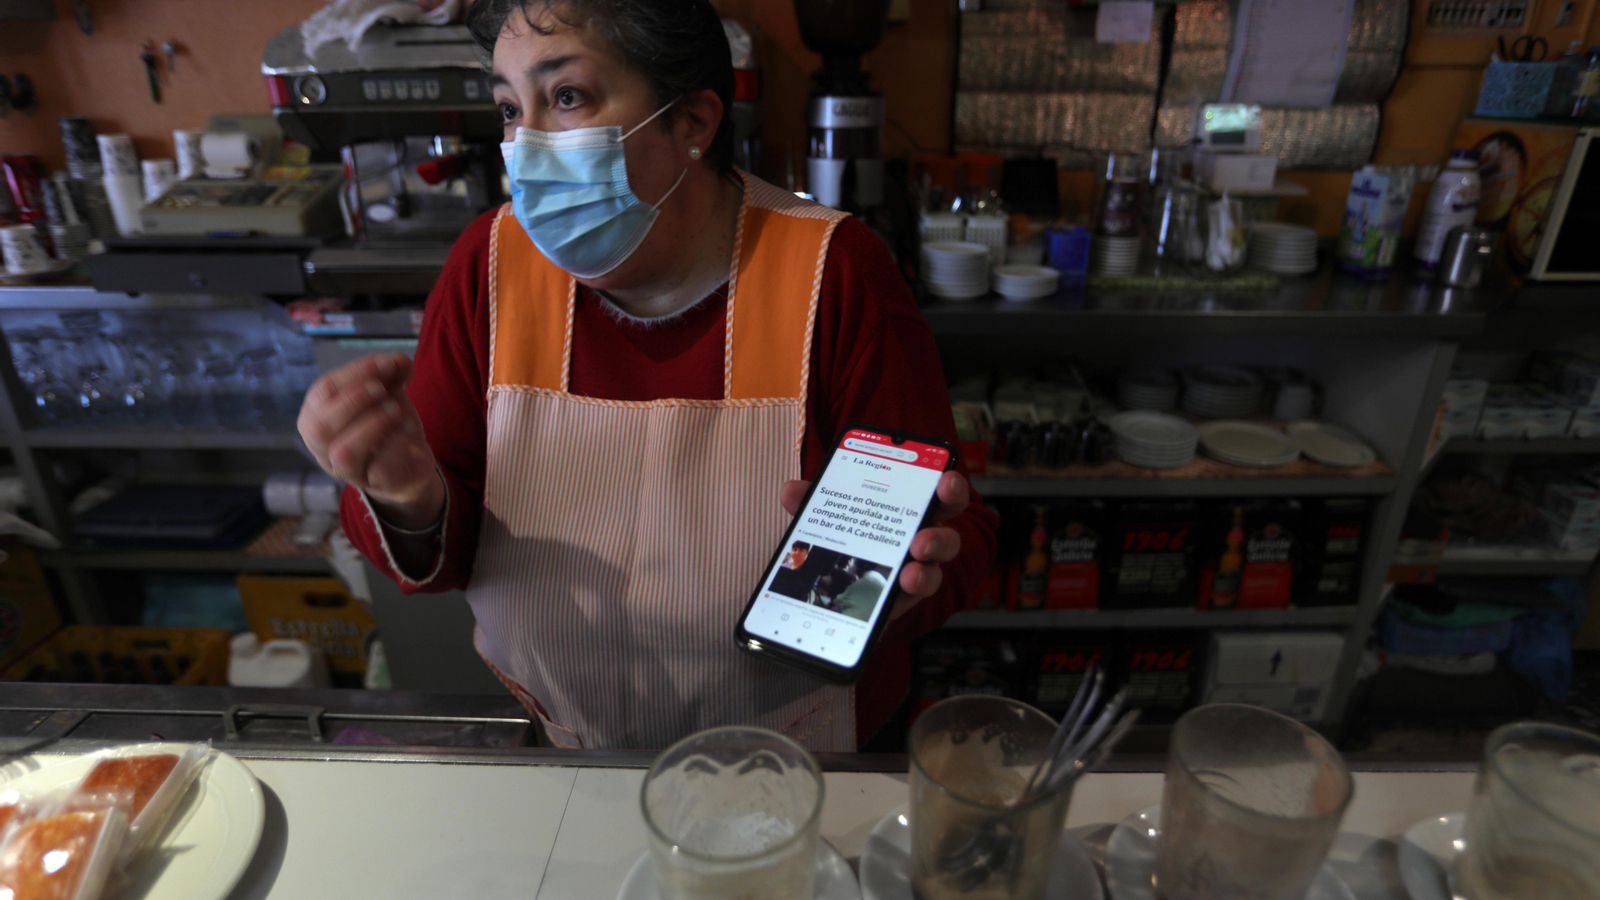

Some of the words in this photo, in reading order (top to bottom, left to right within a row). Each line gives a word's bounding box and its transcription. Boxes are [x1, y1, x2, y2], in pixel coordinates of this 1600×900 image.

[853, 457, 864, 465] La
[820, 487, 852, 502] Sucesos
[853, 495, 864, 504] en
[865, 497, 901, 513] Ourense
[906, 507, 918, 517] Un
[823, 498, 848, 512] joven
[849, 503, 883, 520] apuñala
[891, 515, 903, 524] un
[808, 516, 819, 525] un
[820, 518, 834, 531] bar
[835, 522, 847, 533] de
[847, 525, 853, 534] A
[854, 529, 901, 547] Carballeira
[812, 507, 858, 527] compañero
[859, 516, 870, 527] de
[871, 519, 895, 532] clase
[895, 527, 906, 537] en
[1122, 527, 1190, 554] 1906
